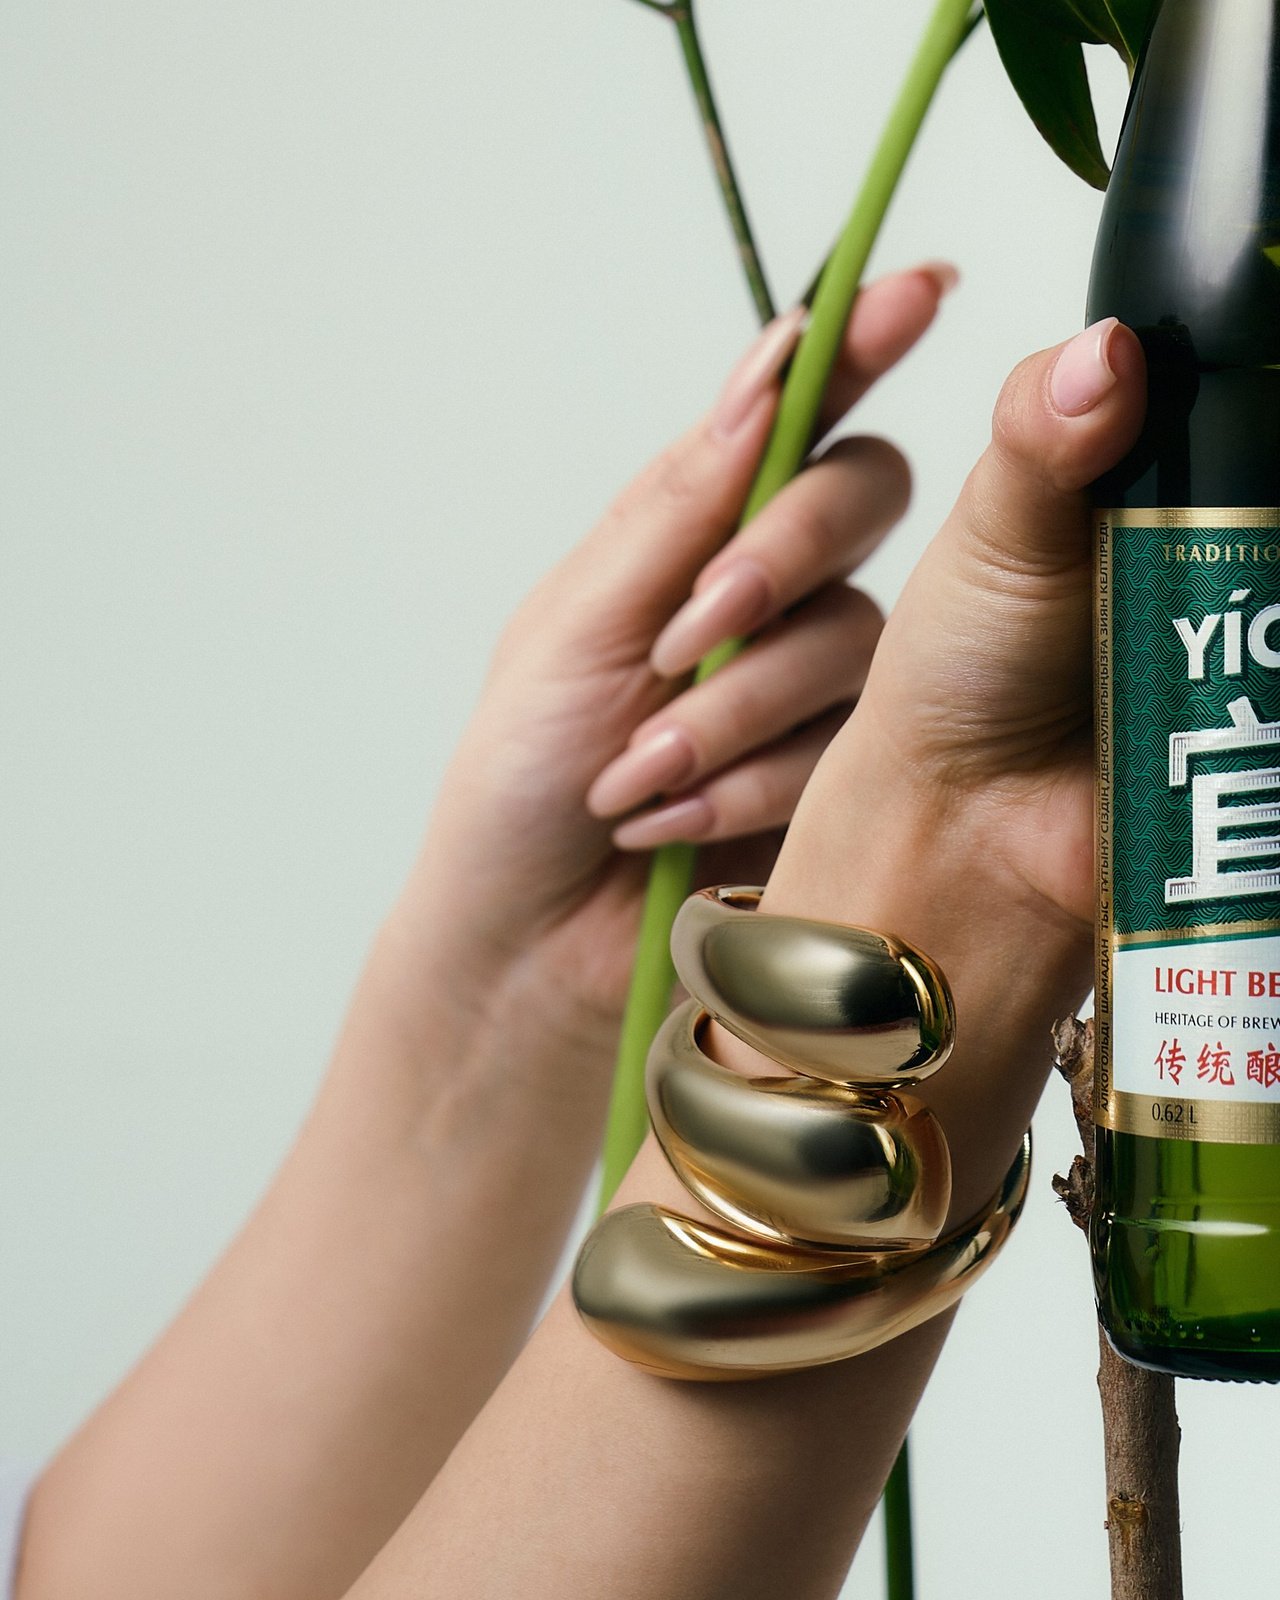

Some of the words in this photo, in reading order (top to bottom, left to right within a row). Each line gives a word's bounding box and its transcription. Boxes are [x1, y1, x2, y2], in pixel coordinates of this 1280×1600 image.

[1100, 598, 1109, 636] ЗИЯН
[1101, 900, 1110, 931] ТЫС
[1101, 938, 1110, 1014] ШАМАДАН
[1155, 967, 1237, 996] LIGHT
[1155, 1012, 1214, 1028] HERITAGE
[1218, 1015, 1237, 1029] OF
[1152, 1103, 1184, 1123] 0.62
[1190, 1105, 1198, 1124] L
